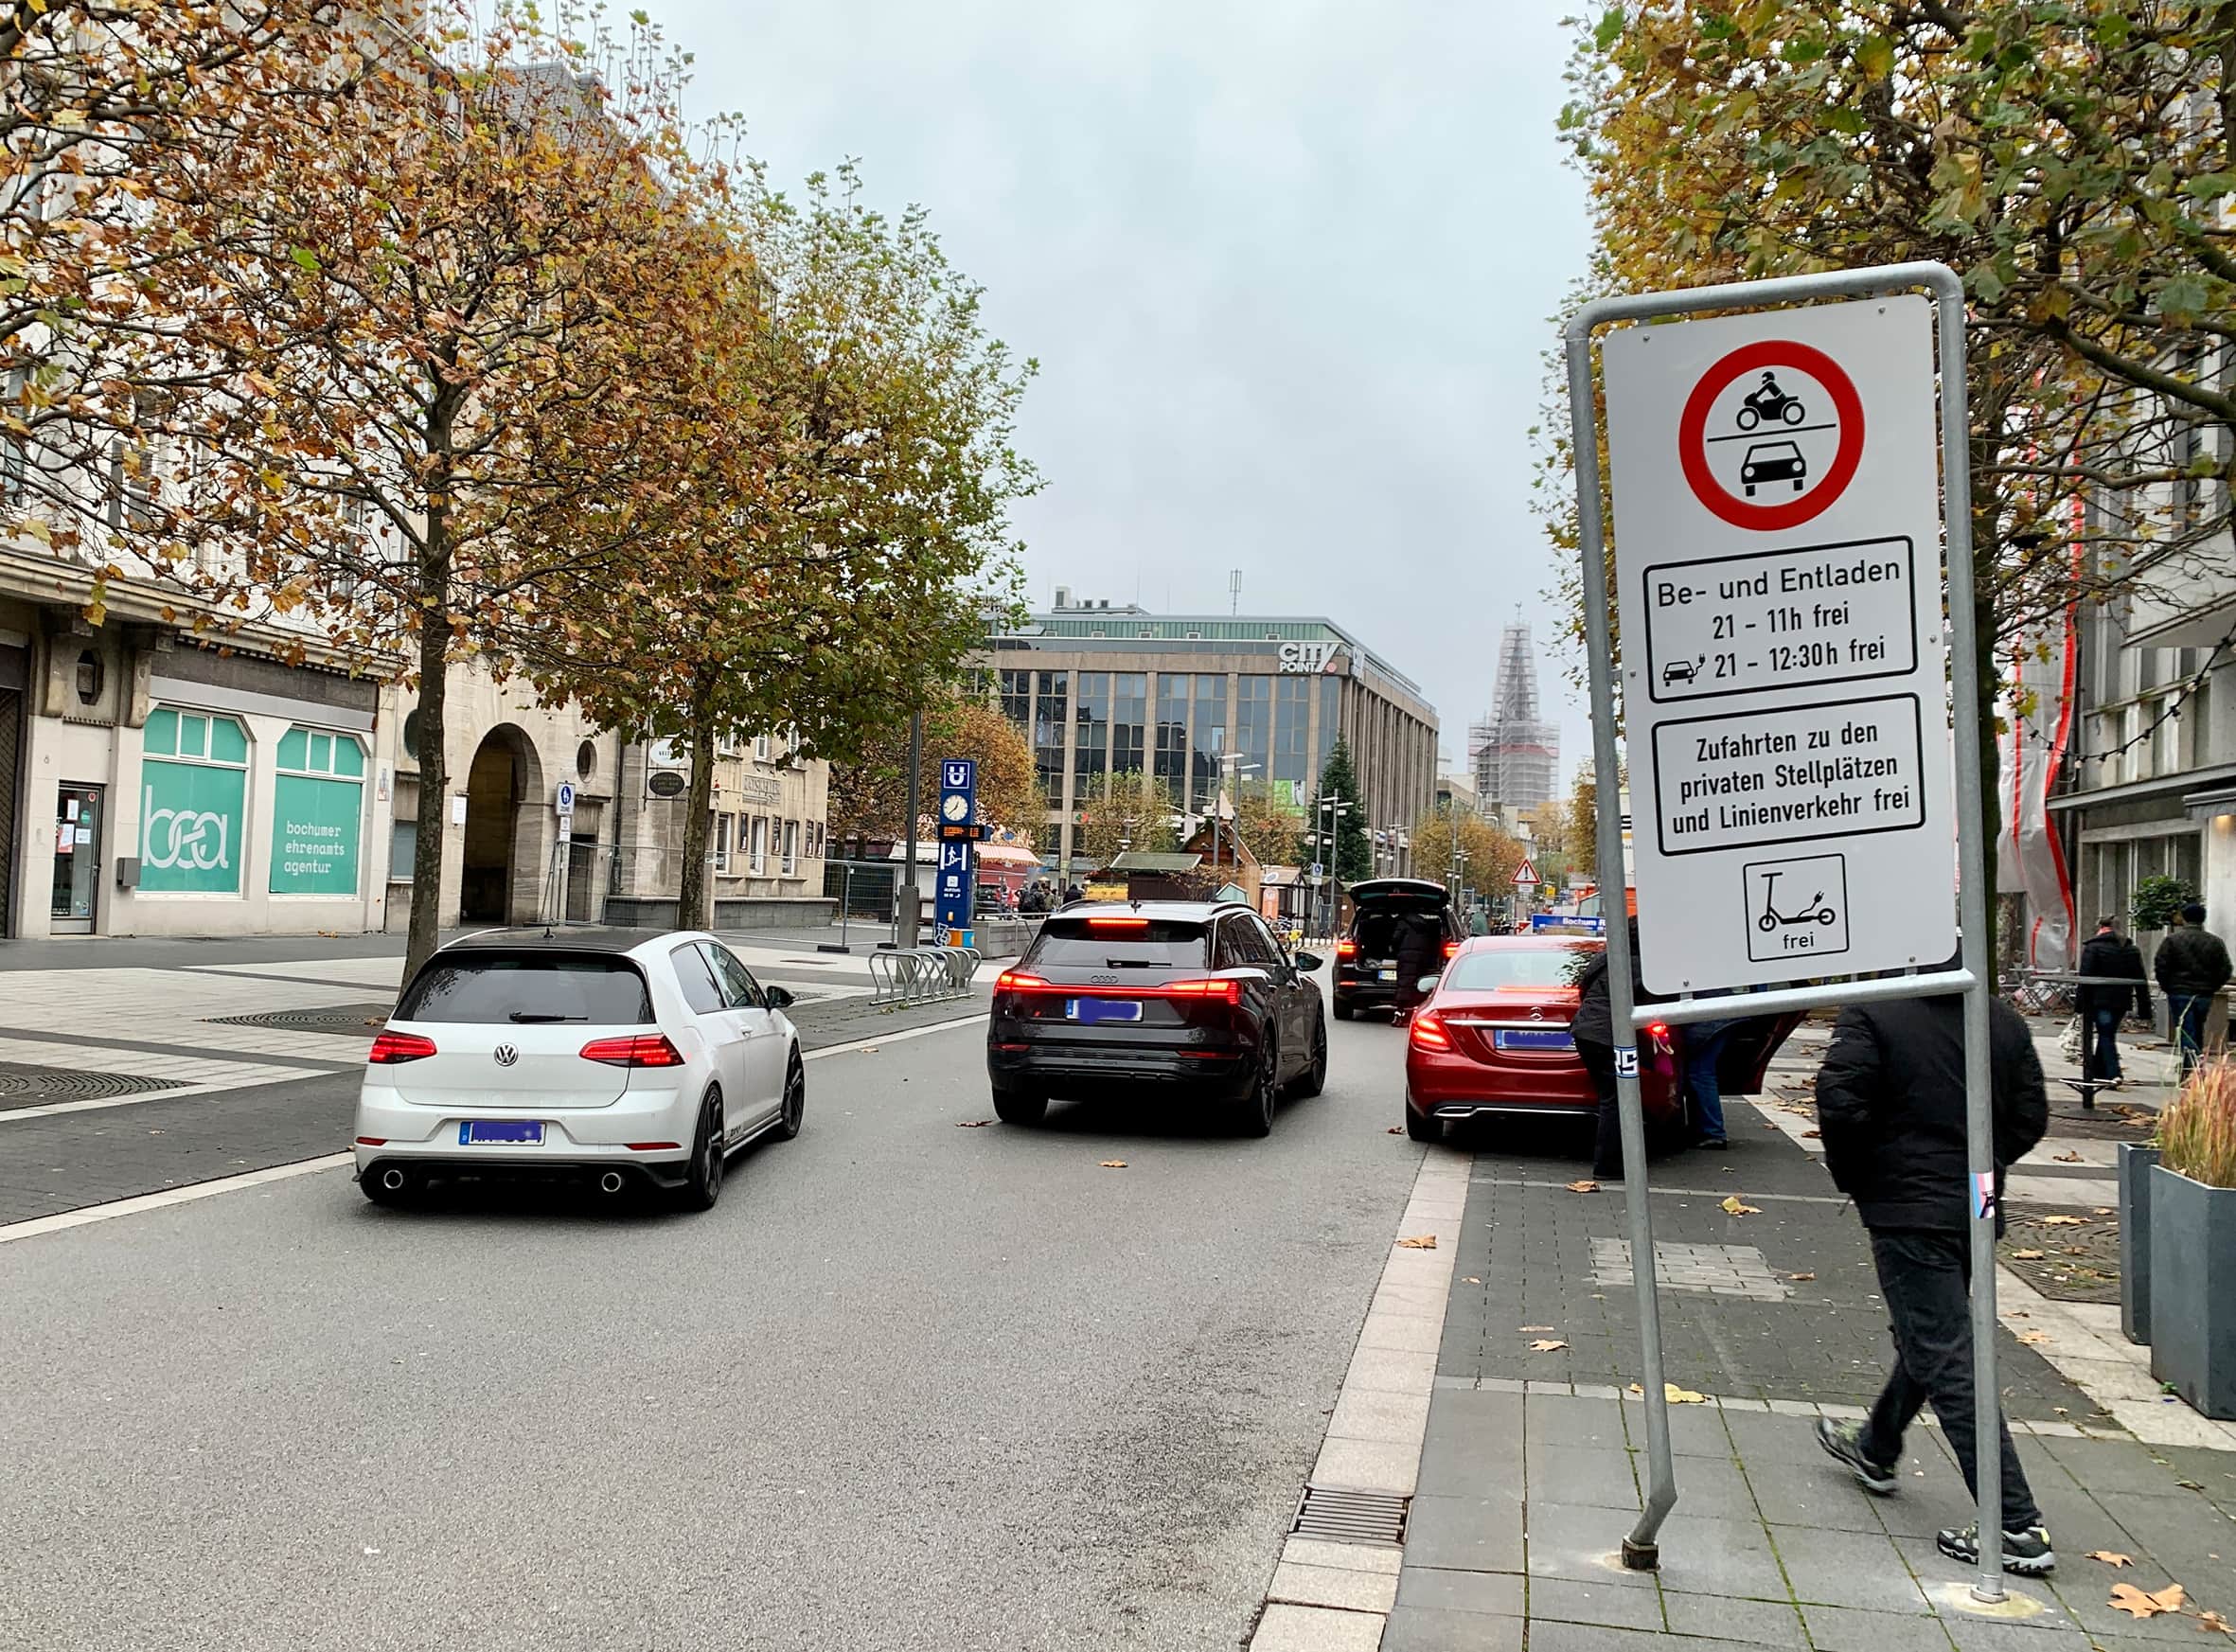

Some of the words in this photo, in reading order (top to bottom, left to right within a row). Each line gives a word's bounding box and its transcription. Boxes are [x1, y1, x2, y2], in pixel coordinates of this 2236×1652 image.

[1658, 581, 1707, 608] Be-
[1719, 570, 1768, 599] und
[1781, 560, 1901, 593] Entladen
[1712, 613, 1734, 640] 21
[1766, 606, 1802, 633] 11h
[1813, 600, 1850, 629] frei
[1278, 642, 1340, 673] CITY
[1279, 661, 1317, 673] POINT
[1713, 652, 1736, 678] 21
[1848, 635, 1886, 663] frei
[1695, 732, 1797, 762] Zufahrten
[1807, 730, 1830, 749] zu
[1840, 721, 1878, 745] den
[1679, 772, 1765, 805] privaten
[1774, 756, 1899, 789] Stellplätzen
[1673, 808, 1710, 834] und
[1719, 791, 1863, 829] Linienverkehr
[1873, 785, 1910, 812] frei
[286, 820, 342, 837] bochumer
[285, 839, 346, 857] ehrenamts
[283, 859, 332, 877] agentur
[1562, 916, 1597, 927] Bochum
[1783, 932, 1815, 950] frei
